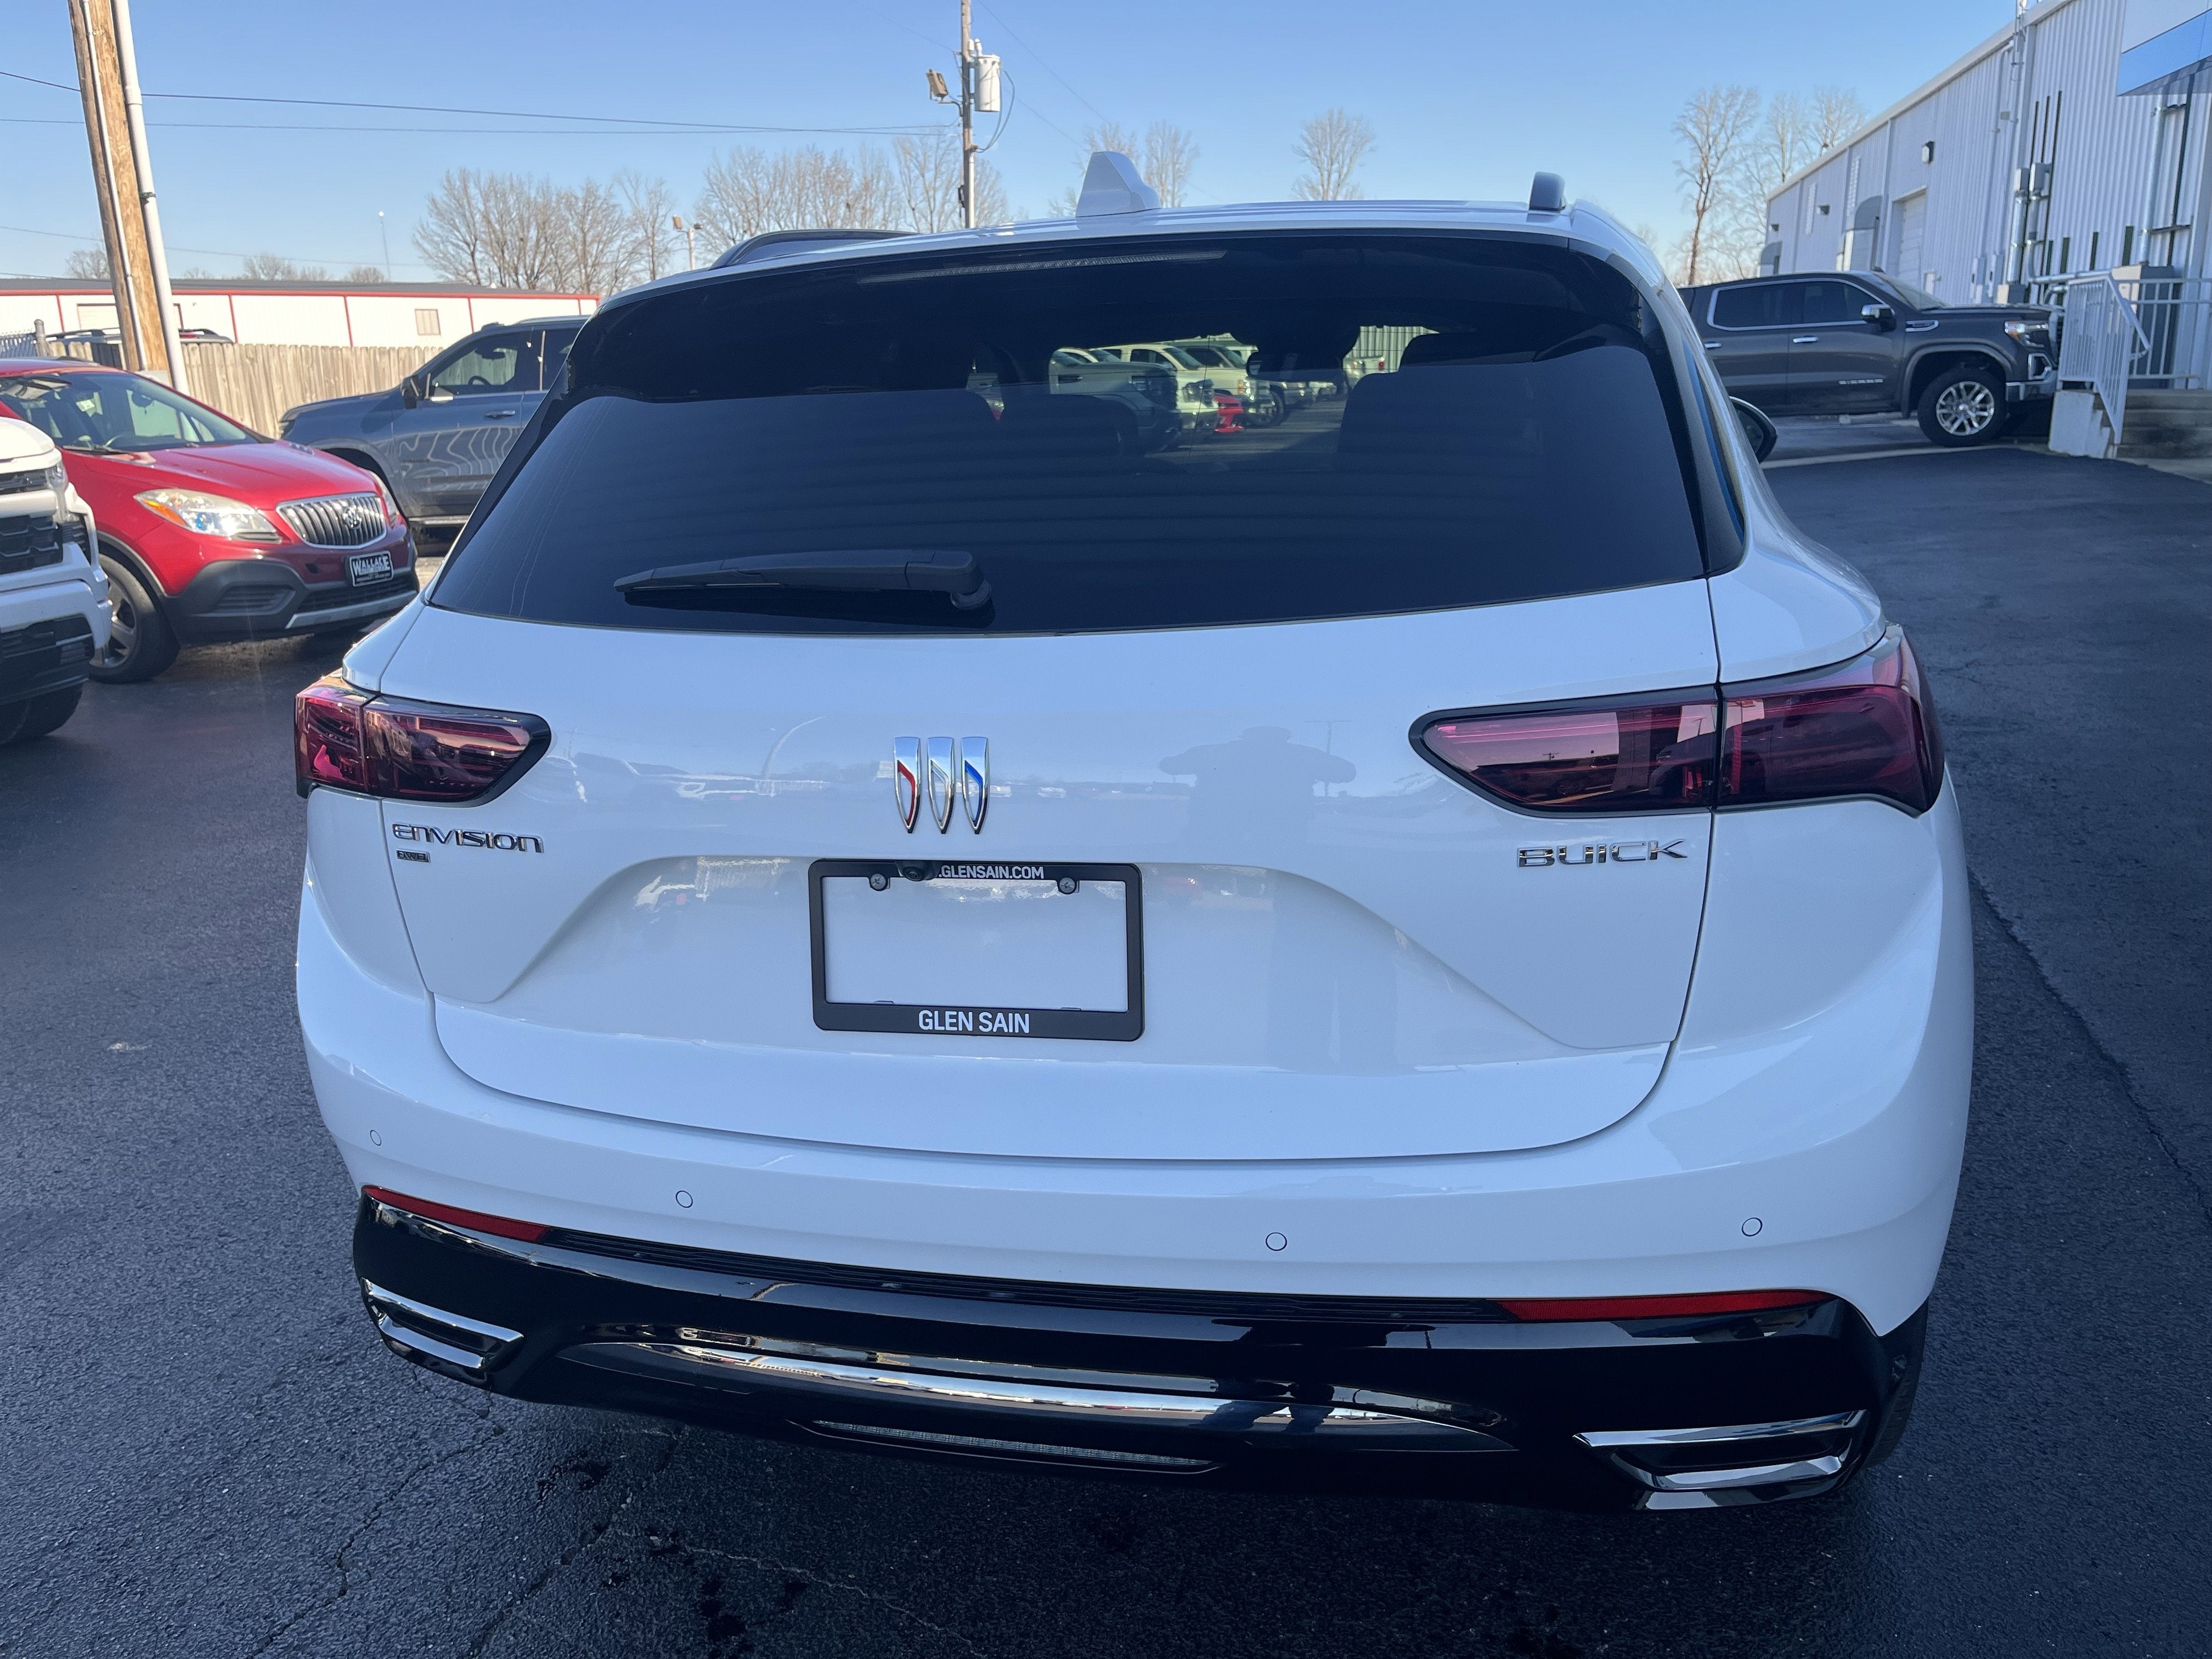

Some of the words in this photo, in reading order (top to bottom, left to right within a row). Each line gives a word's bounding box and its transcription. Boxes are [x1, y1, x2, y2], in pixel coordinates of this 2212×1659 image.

[392, 823, 544, 854] ENVISION
[1517, 839, 1688, 867] BUICK
[898, 865, 1044, 879] .GLENSAIN.COM
[918, 1010, 973, 1031] GLEN
[979, 1012, 1029, 1033] SAIN
